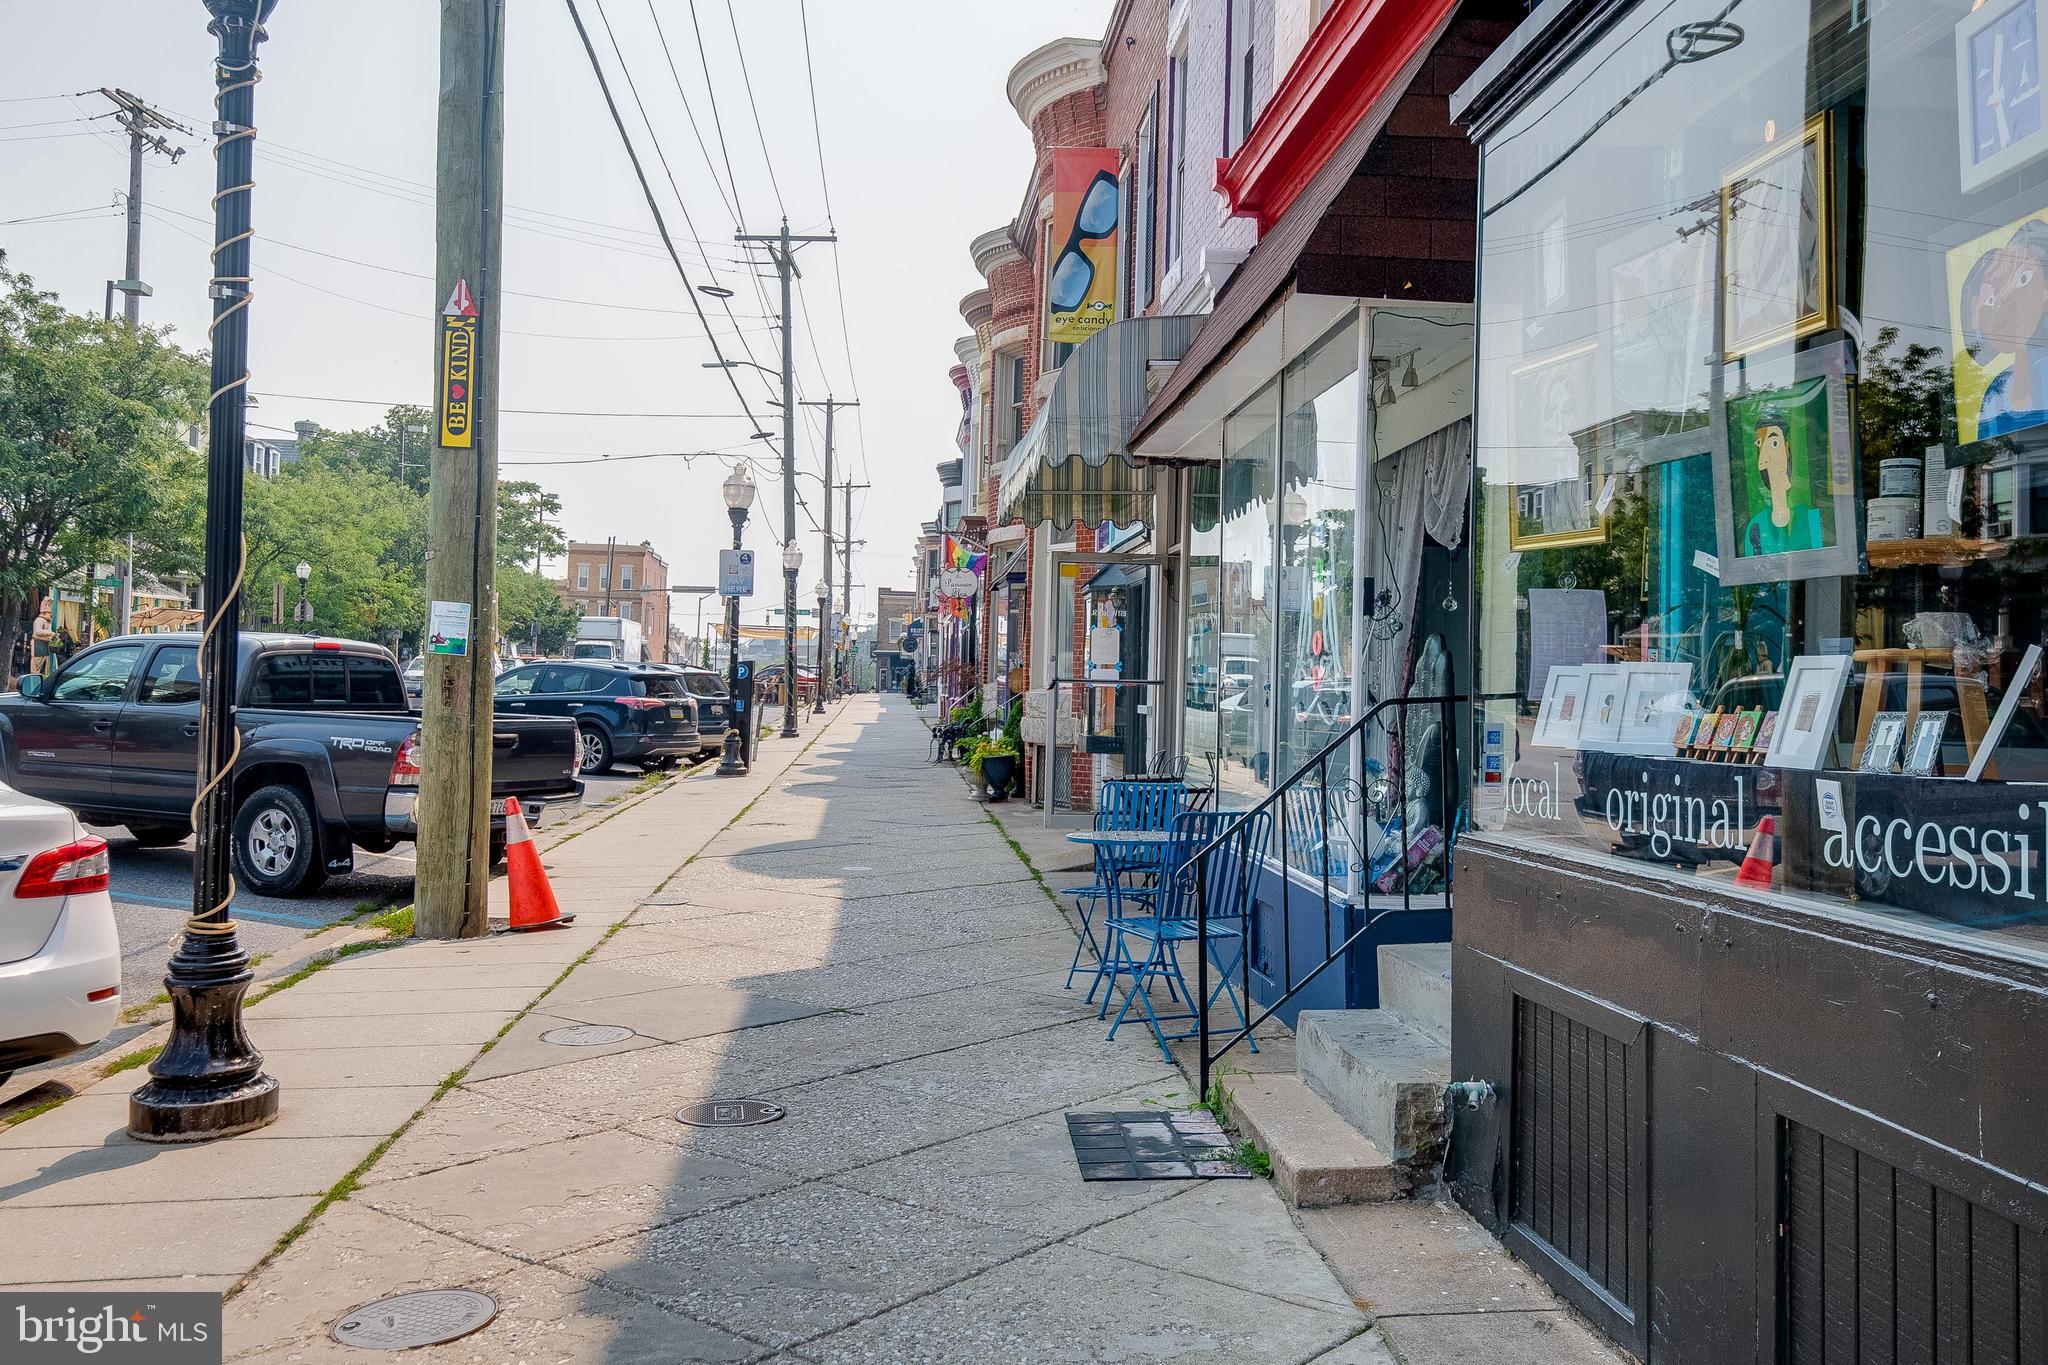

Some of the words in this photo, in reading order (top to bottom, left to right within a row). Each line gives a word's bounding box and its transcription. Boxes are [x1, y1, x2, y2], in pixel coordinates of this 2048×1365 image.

[1055, 316, 1075, 325] eye
[1077, 311, 1111, 327] candy
[450, 331, 469, 382] KIND
[448, 402, 466, 429] BE
[741, 553, 749, 561] 4
[738, 666, 745, 677] P
[330, 736, 365, 751] TRD
[364, 745, 392, 753] ROAD
[1504, 759, 1562, 821] local
[1606, 771, 1748, 858] original
[1823, 801, 2048, 902] accessi
